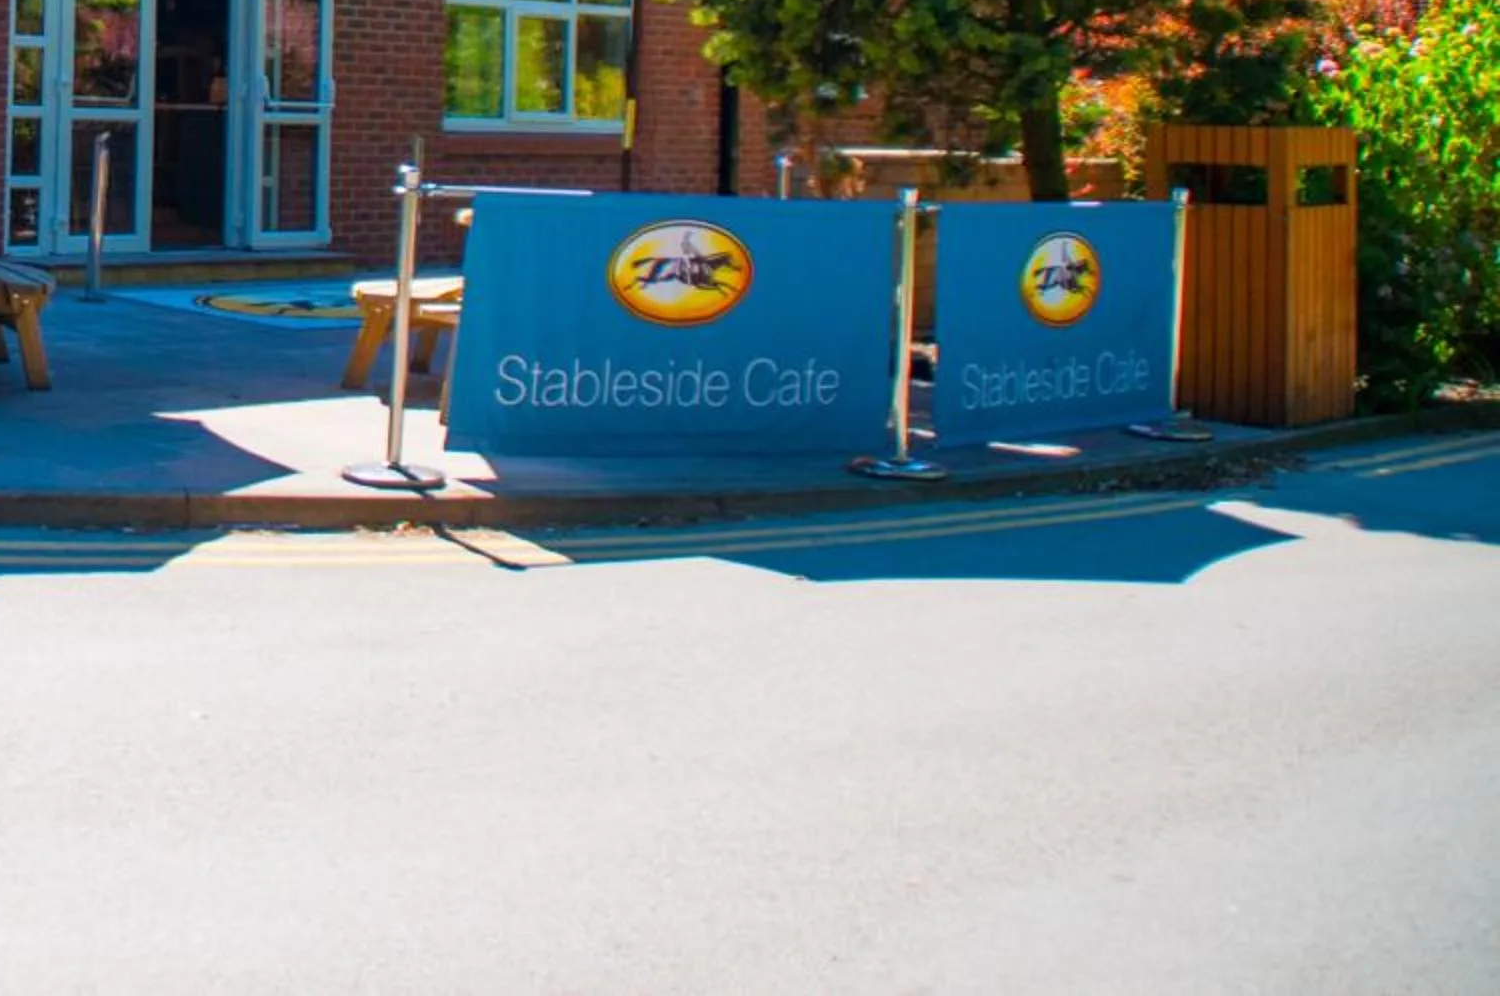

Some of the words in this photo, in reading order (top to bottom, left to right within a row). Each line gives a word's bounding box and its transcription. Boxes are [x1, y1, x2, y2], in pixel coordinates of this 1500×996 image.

[494, 354, 731, 406] Stableside
[743, 357, 840, 406] Cafe
[962, 355, 1091, 410] Stableside
[1096, 349, 1150, 395] Cafe
